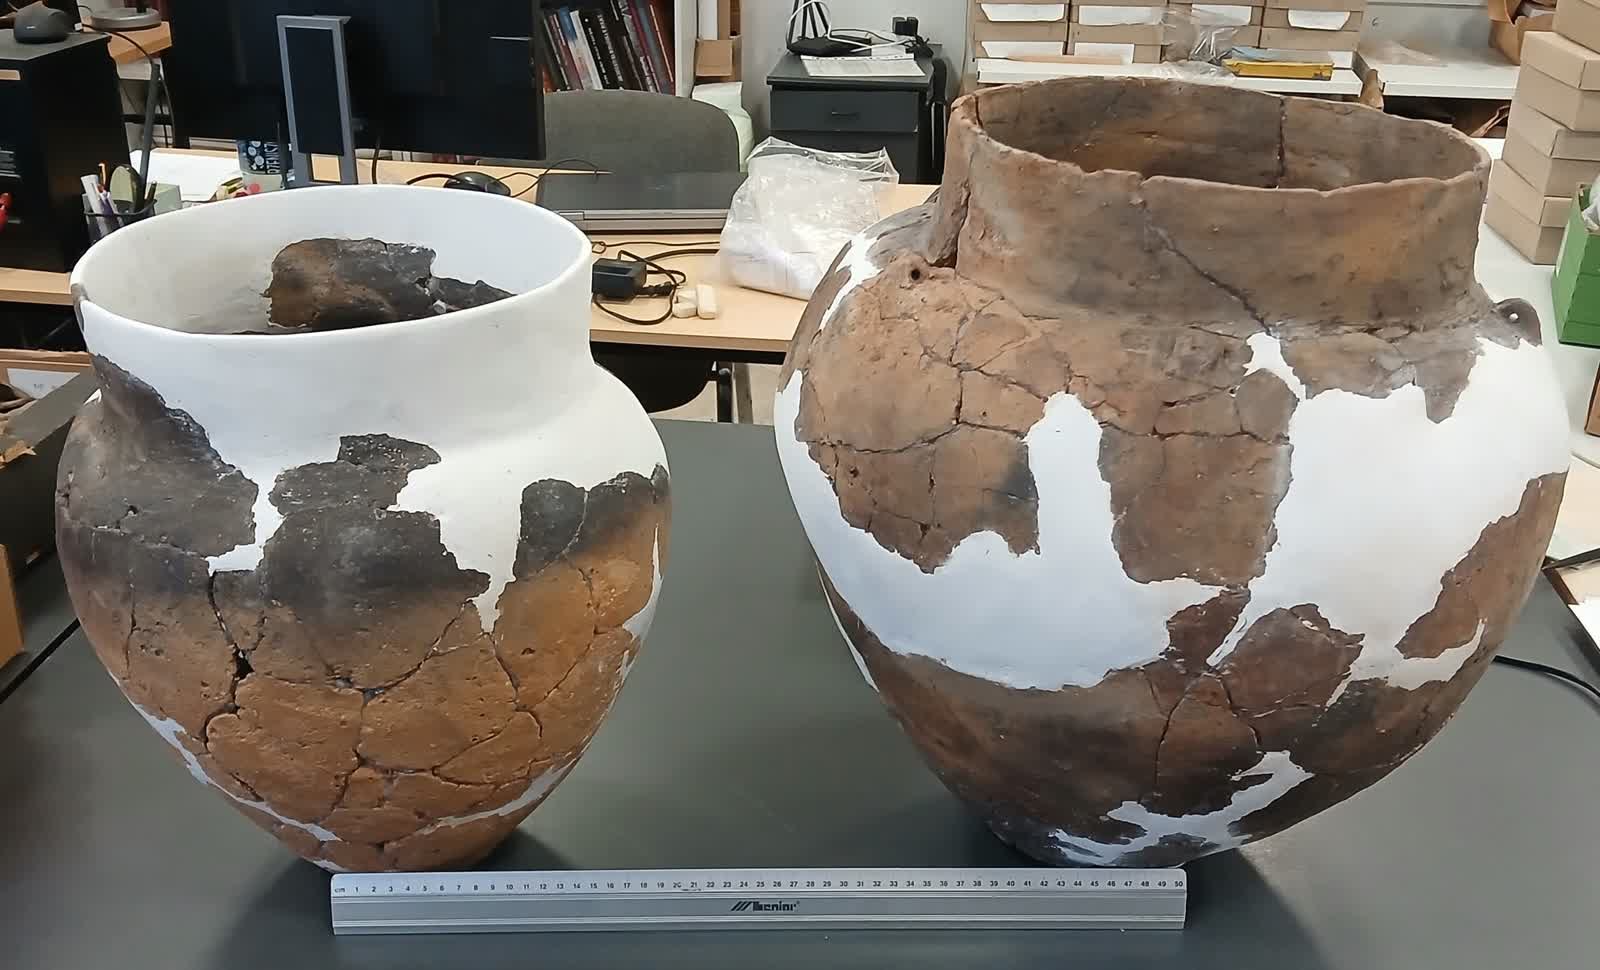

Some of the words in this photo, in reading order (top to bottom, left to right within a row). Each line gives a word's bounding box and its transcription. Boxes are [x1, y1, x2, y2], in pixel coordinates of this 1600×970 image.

[506, 883, 514, 891] 10
[656, 881, 665, 889] 19
[772, 880, 782, 888] 26
[789, 880, 799, 888] 27
[805, 880, 815, 888] 28
[839, 880, 849, 888] 30
[1157, 880, 1167, 888] 49
[1174, 880, 1184, 888] 50
